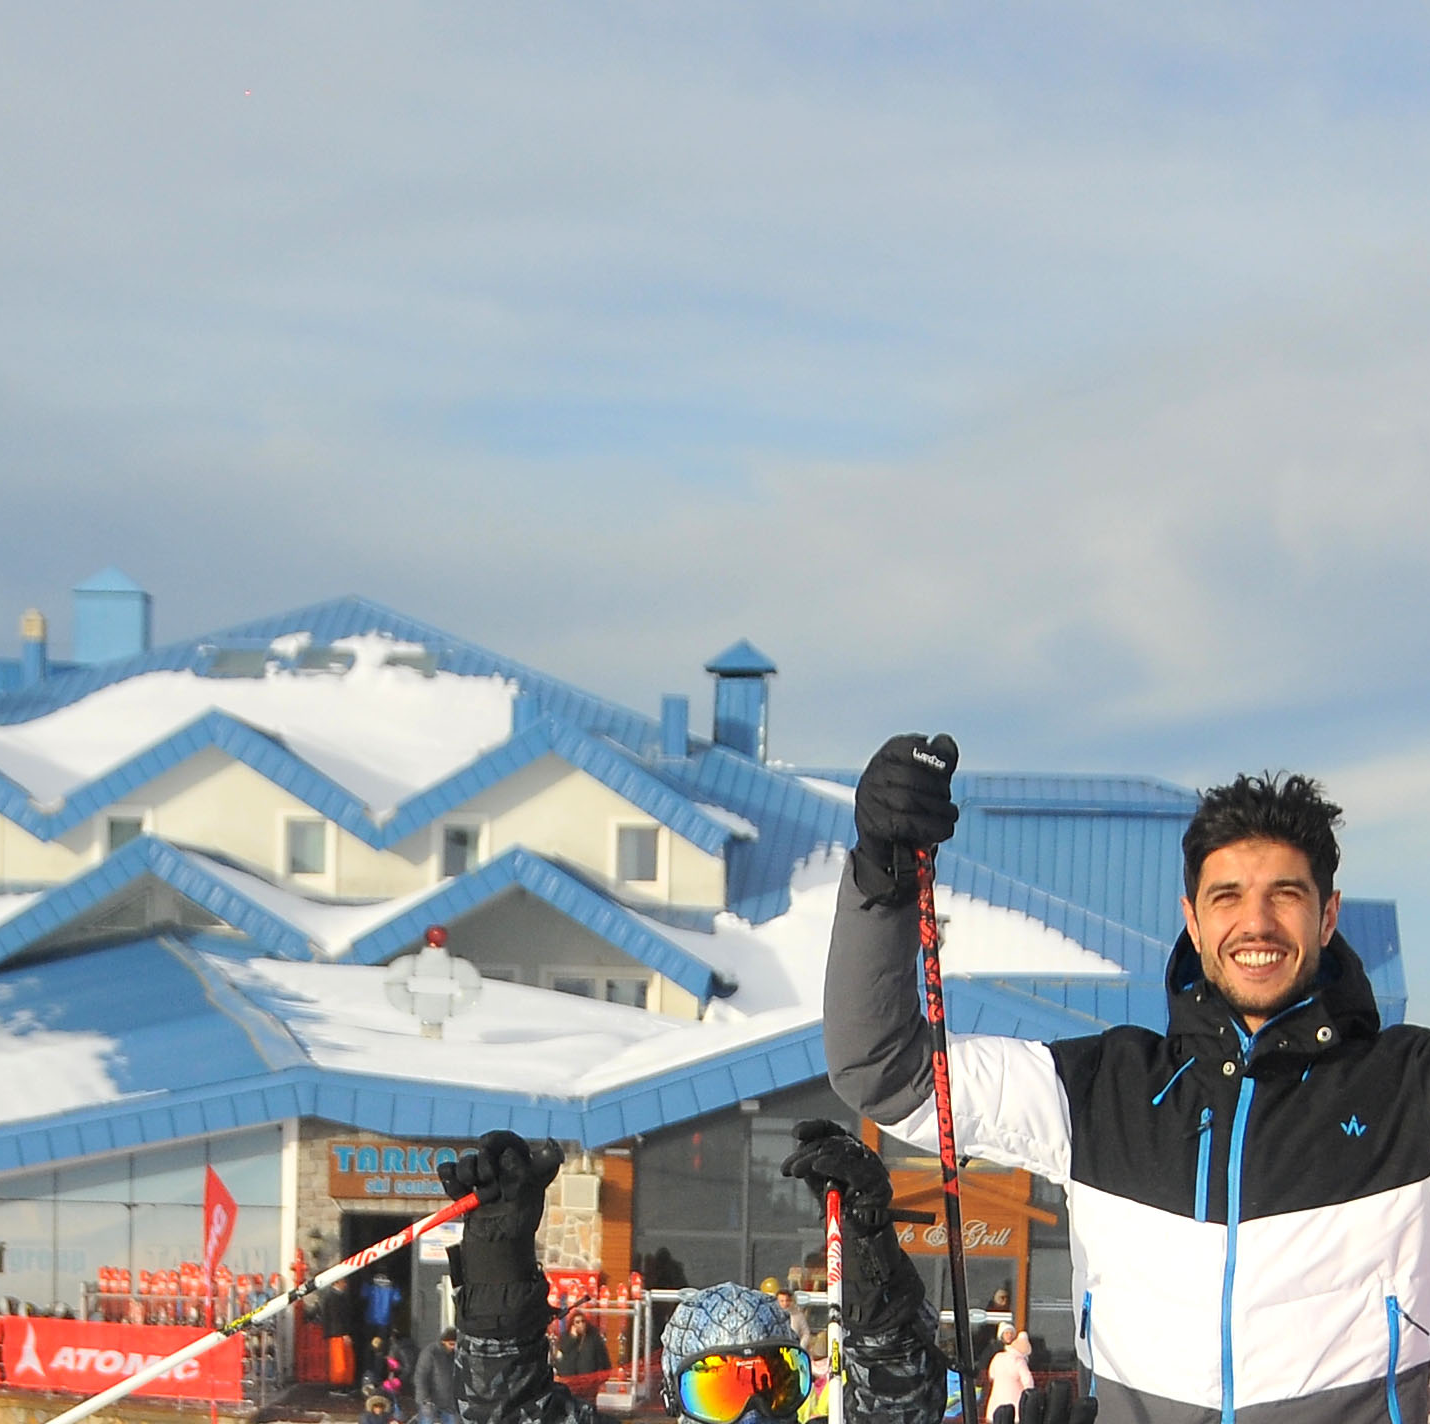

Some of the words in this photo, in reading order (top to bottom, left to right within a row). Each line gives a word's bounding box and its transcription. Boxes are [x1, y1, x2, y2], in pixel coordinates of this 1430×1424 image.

[932, 1051, 955, 1170] ATOMIC
[332, 1144, 480, 1174] TARKA
[960, 1219, 1012, 1249] Grill
[49, 1346, 201, 1381] ATOMC
